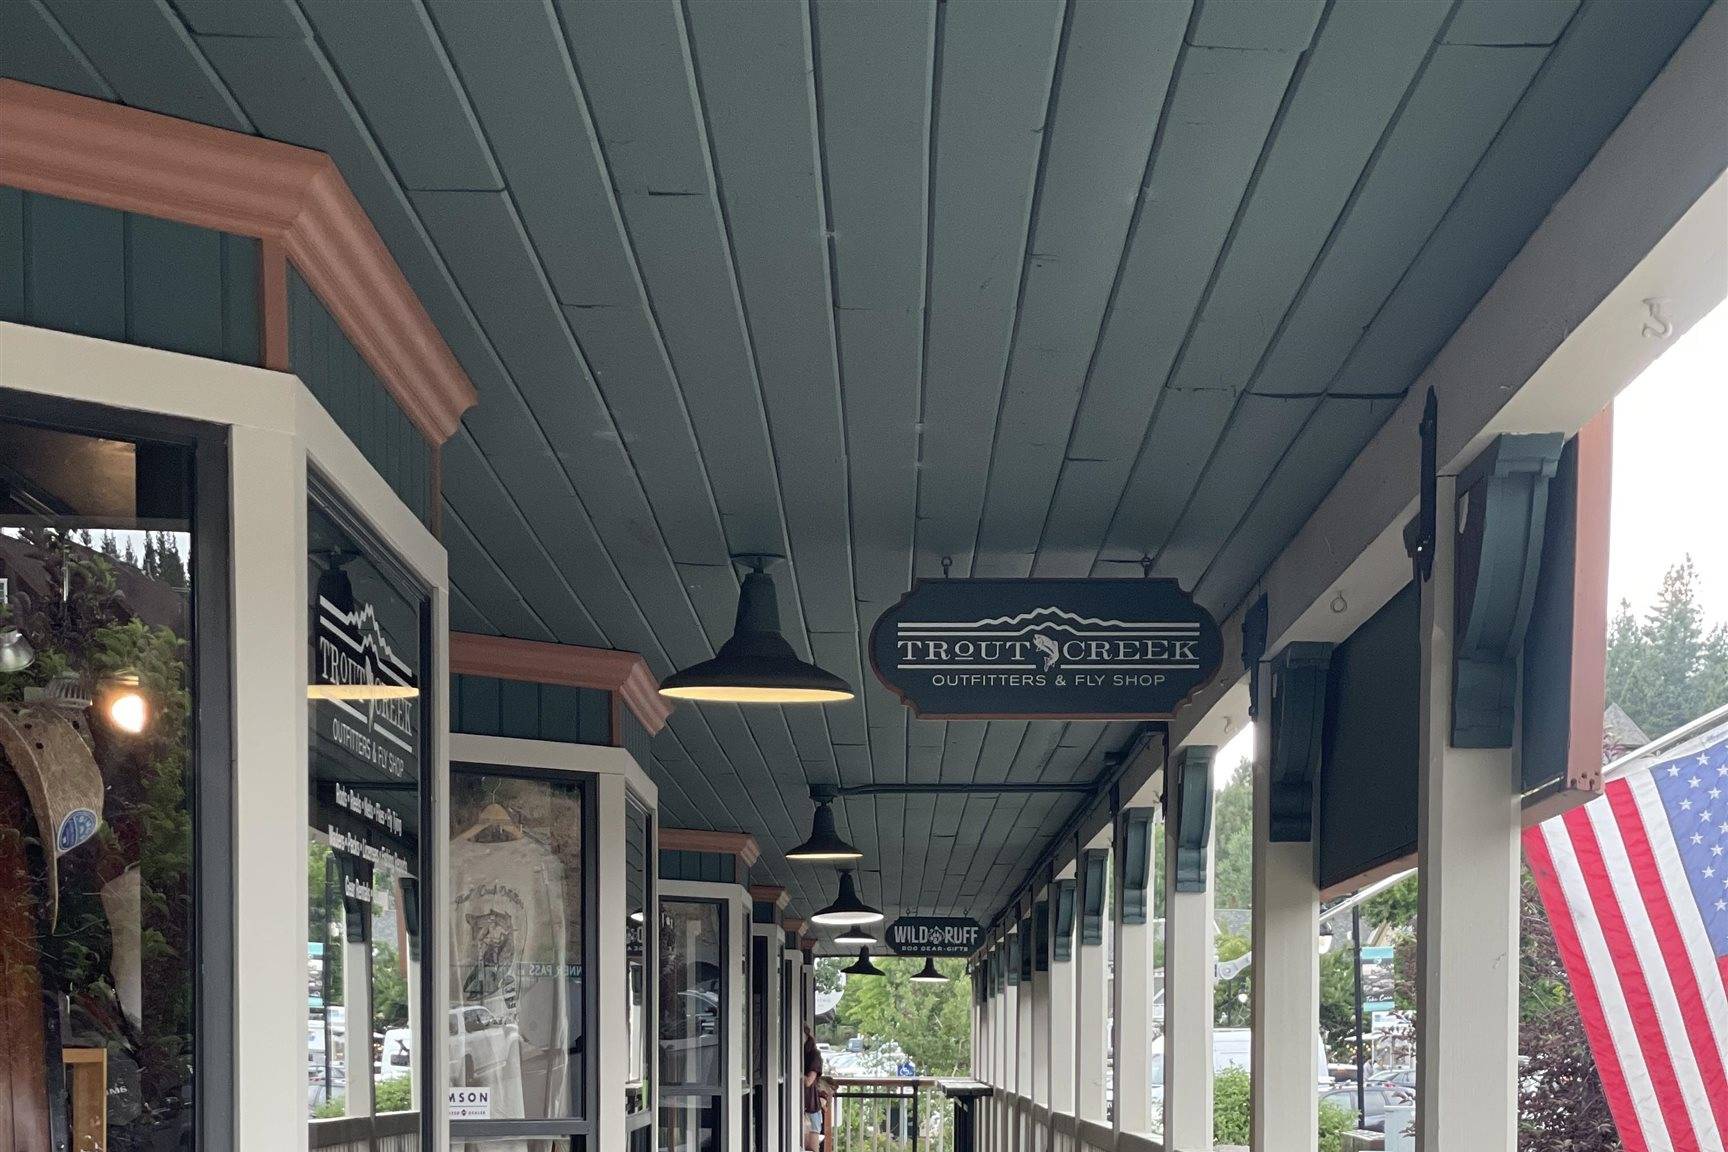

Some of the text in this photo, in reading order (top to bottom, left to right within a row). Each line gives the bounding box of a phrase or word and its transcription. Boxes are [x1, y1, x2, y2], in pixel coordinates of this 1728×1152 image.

[898, 640, 1200, 661] TROUT CREEK
[319, 635, 366, 703] TROUT
[932, 674, 1166, 687] OUTFITTERS & FLY SHOP
[332, 717, 371, 760] OUTFITTERS
[378, 745, 388, 769] FLY
[388, 752, 405, 778] SHOP
[894, 925, 979, 945] WILD RUFF
